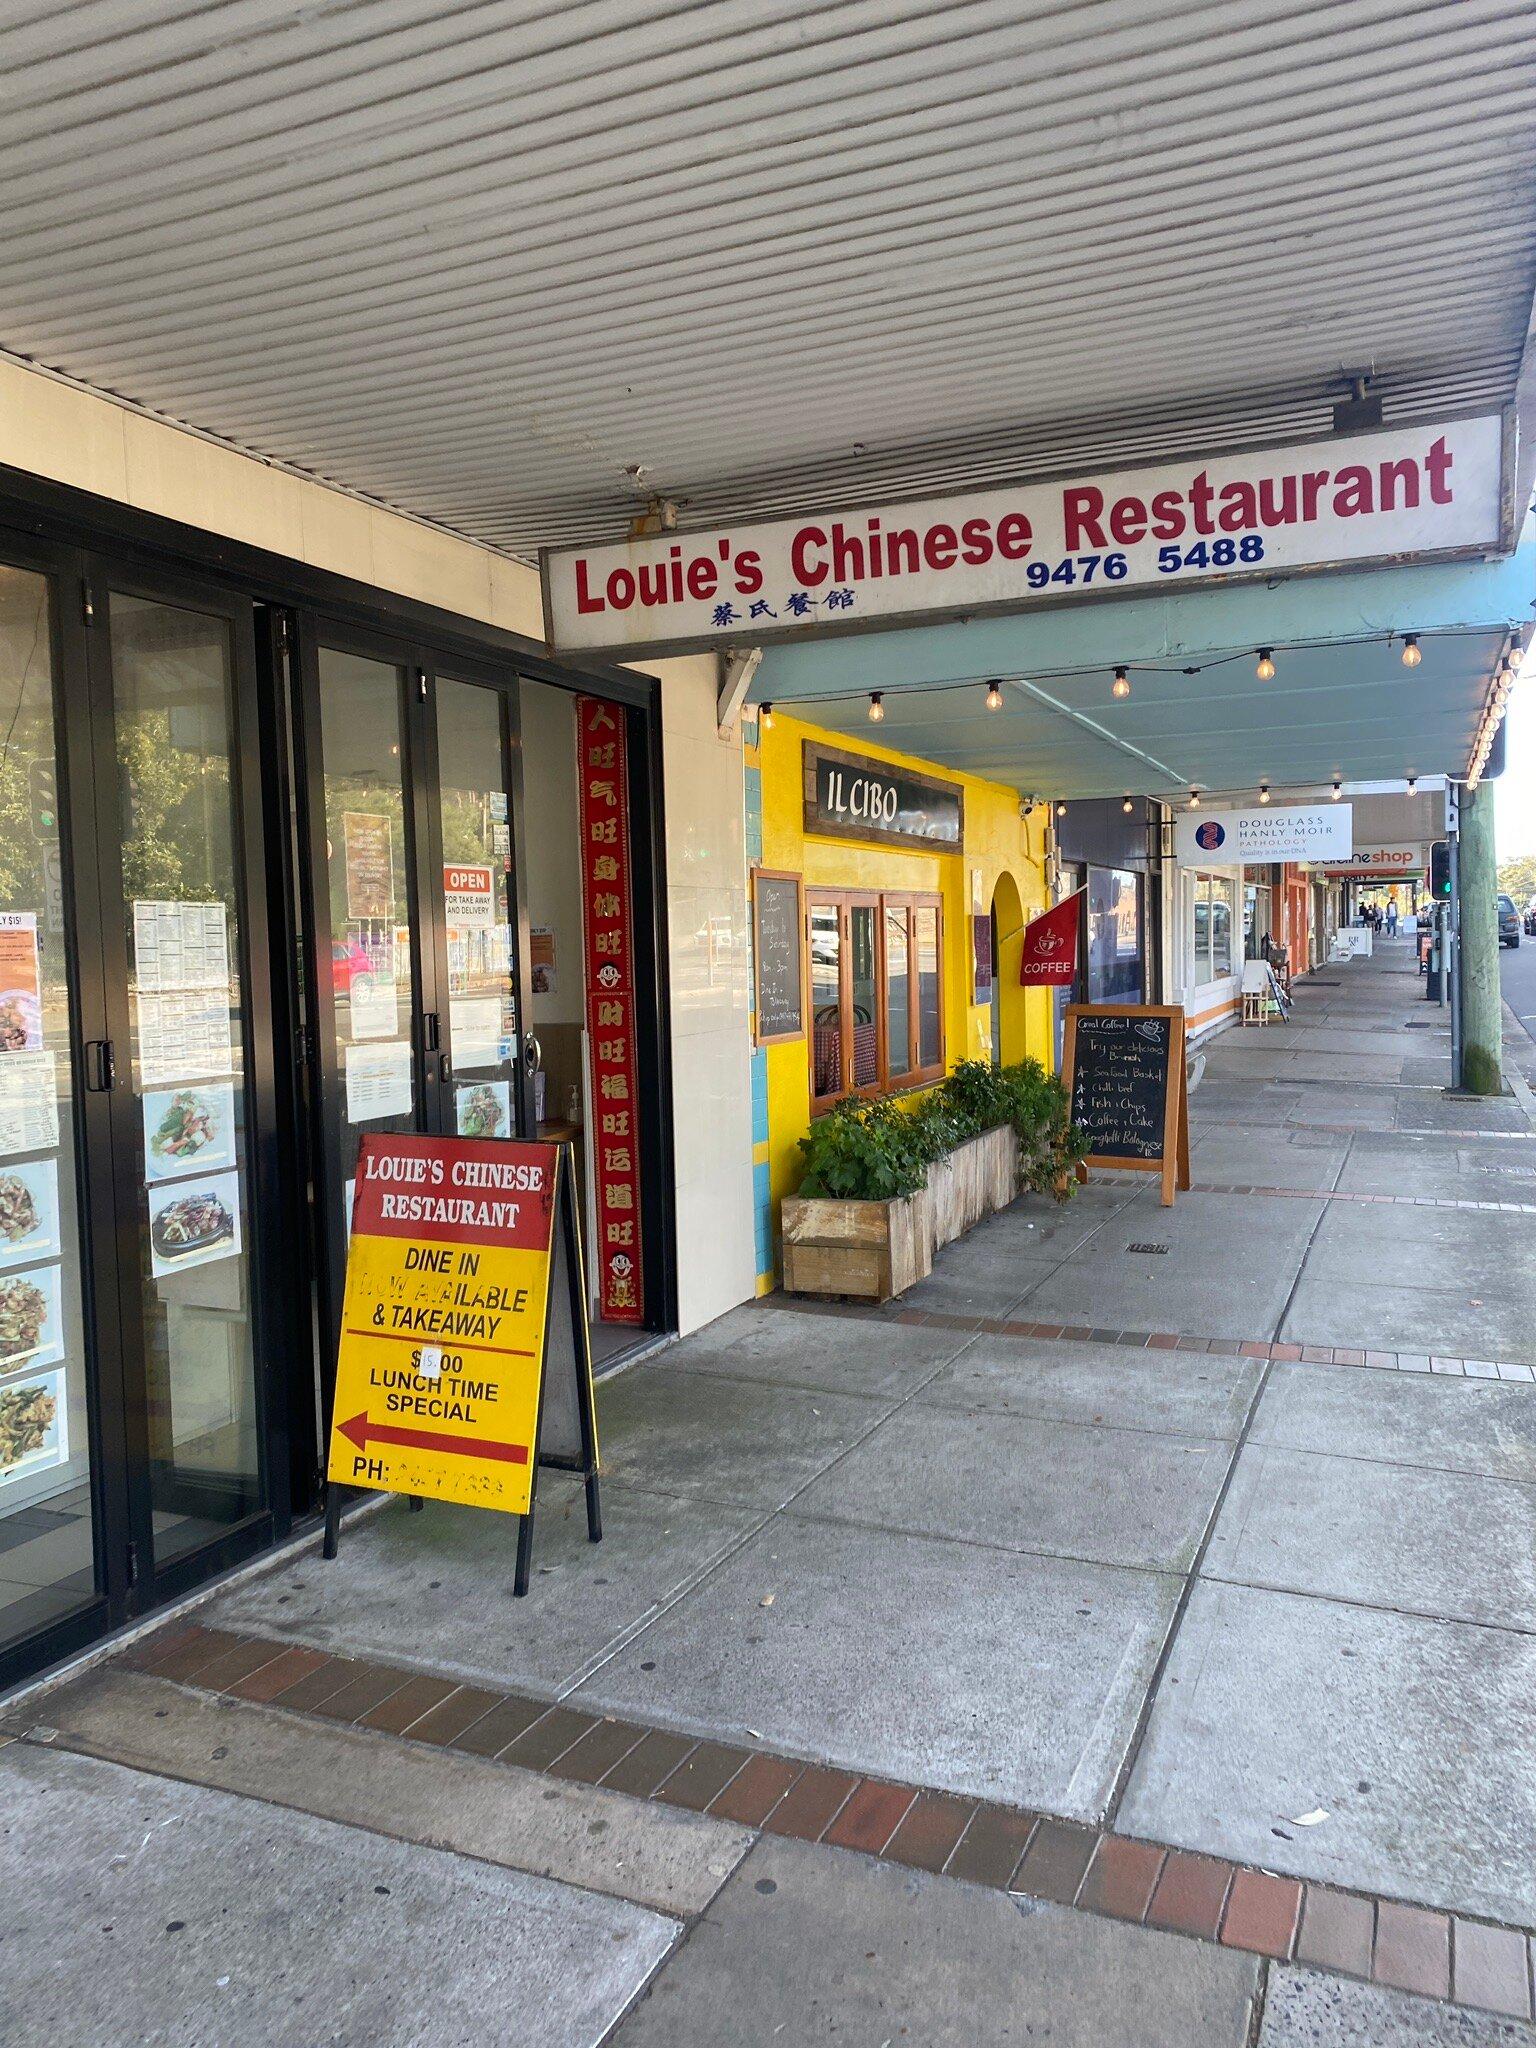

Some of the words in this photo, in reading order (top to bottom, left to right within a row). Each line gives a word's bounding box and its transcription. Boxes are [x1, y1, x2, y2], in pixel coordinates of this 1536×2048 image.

[575, 538, 764, 615] Louie's
[791, 512, 1033, 588] Chinese
[1062, 435, 1454, 553] Restaurant
[1026, 552, 1129, 589] 9476
[1158, 535, 1265, 573] 5488
[709, 588, 856, 628] 蔡氏餐館
[827, 770, 848, 813] IL
[850, 778, 898, 823] CIBO
[1239, 816, 1324, 829] DOUGLASS
[1239, 828, 1286, 838] HANLY
[1294, 826, 1333, 836] MOIR
[1239, 838, 1308, 847] PATHOLOGY
[451, 872, 485, 889] OPEN
[445, 895, 457, 904] FOR
[459, 896, 474, 904] TAKE
[475, 896, 490, 904] AWAY
[447, 906, 461, 915] AND
[461, 906, 490, 915] DELIVERY
[1024, 961, 1072, 974] COFFEE
[1089, 1039, 1106, 1058] Try
[1091, 1096, 1112, 1108] Fish
[1120, 1097, 1146, 1115] Chips
[1088, 1112, 1119, 1128] Coffee
[1129, 1112, 1153, 1128] Cake
[365, 1155, 444, 1185] LOUIE'S
[451, 1161, 543, 1192] CHINESE
[381, 1193, 520, 1229] RESTAURANT
[404, 1247, 454, 1274] DINE
[458, 1252, 481, 1277] IN
[372, 1302, 385, 1327] &
[391, 1304, 503, 1340] TAKEAWAY
[369, 1368, 443, 1395] LUNCH
[449, 1377, 499, 1402] TIME
[386, 1393, 478, 1424] SPECIAL
[352, 1456, 390, 1482] PH:
